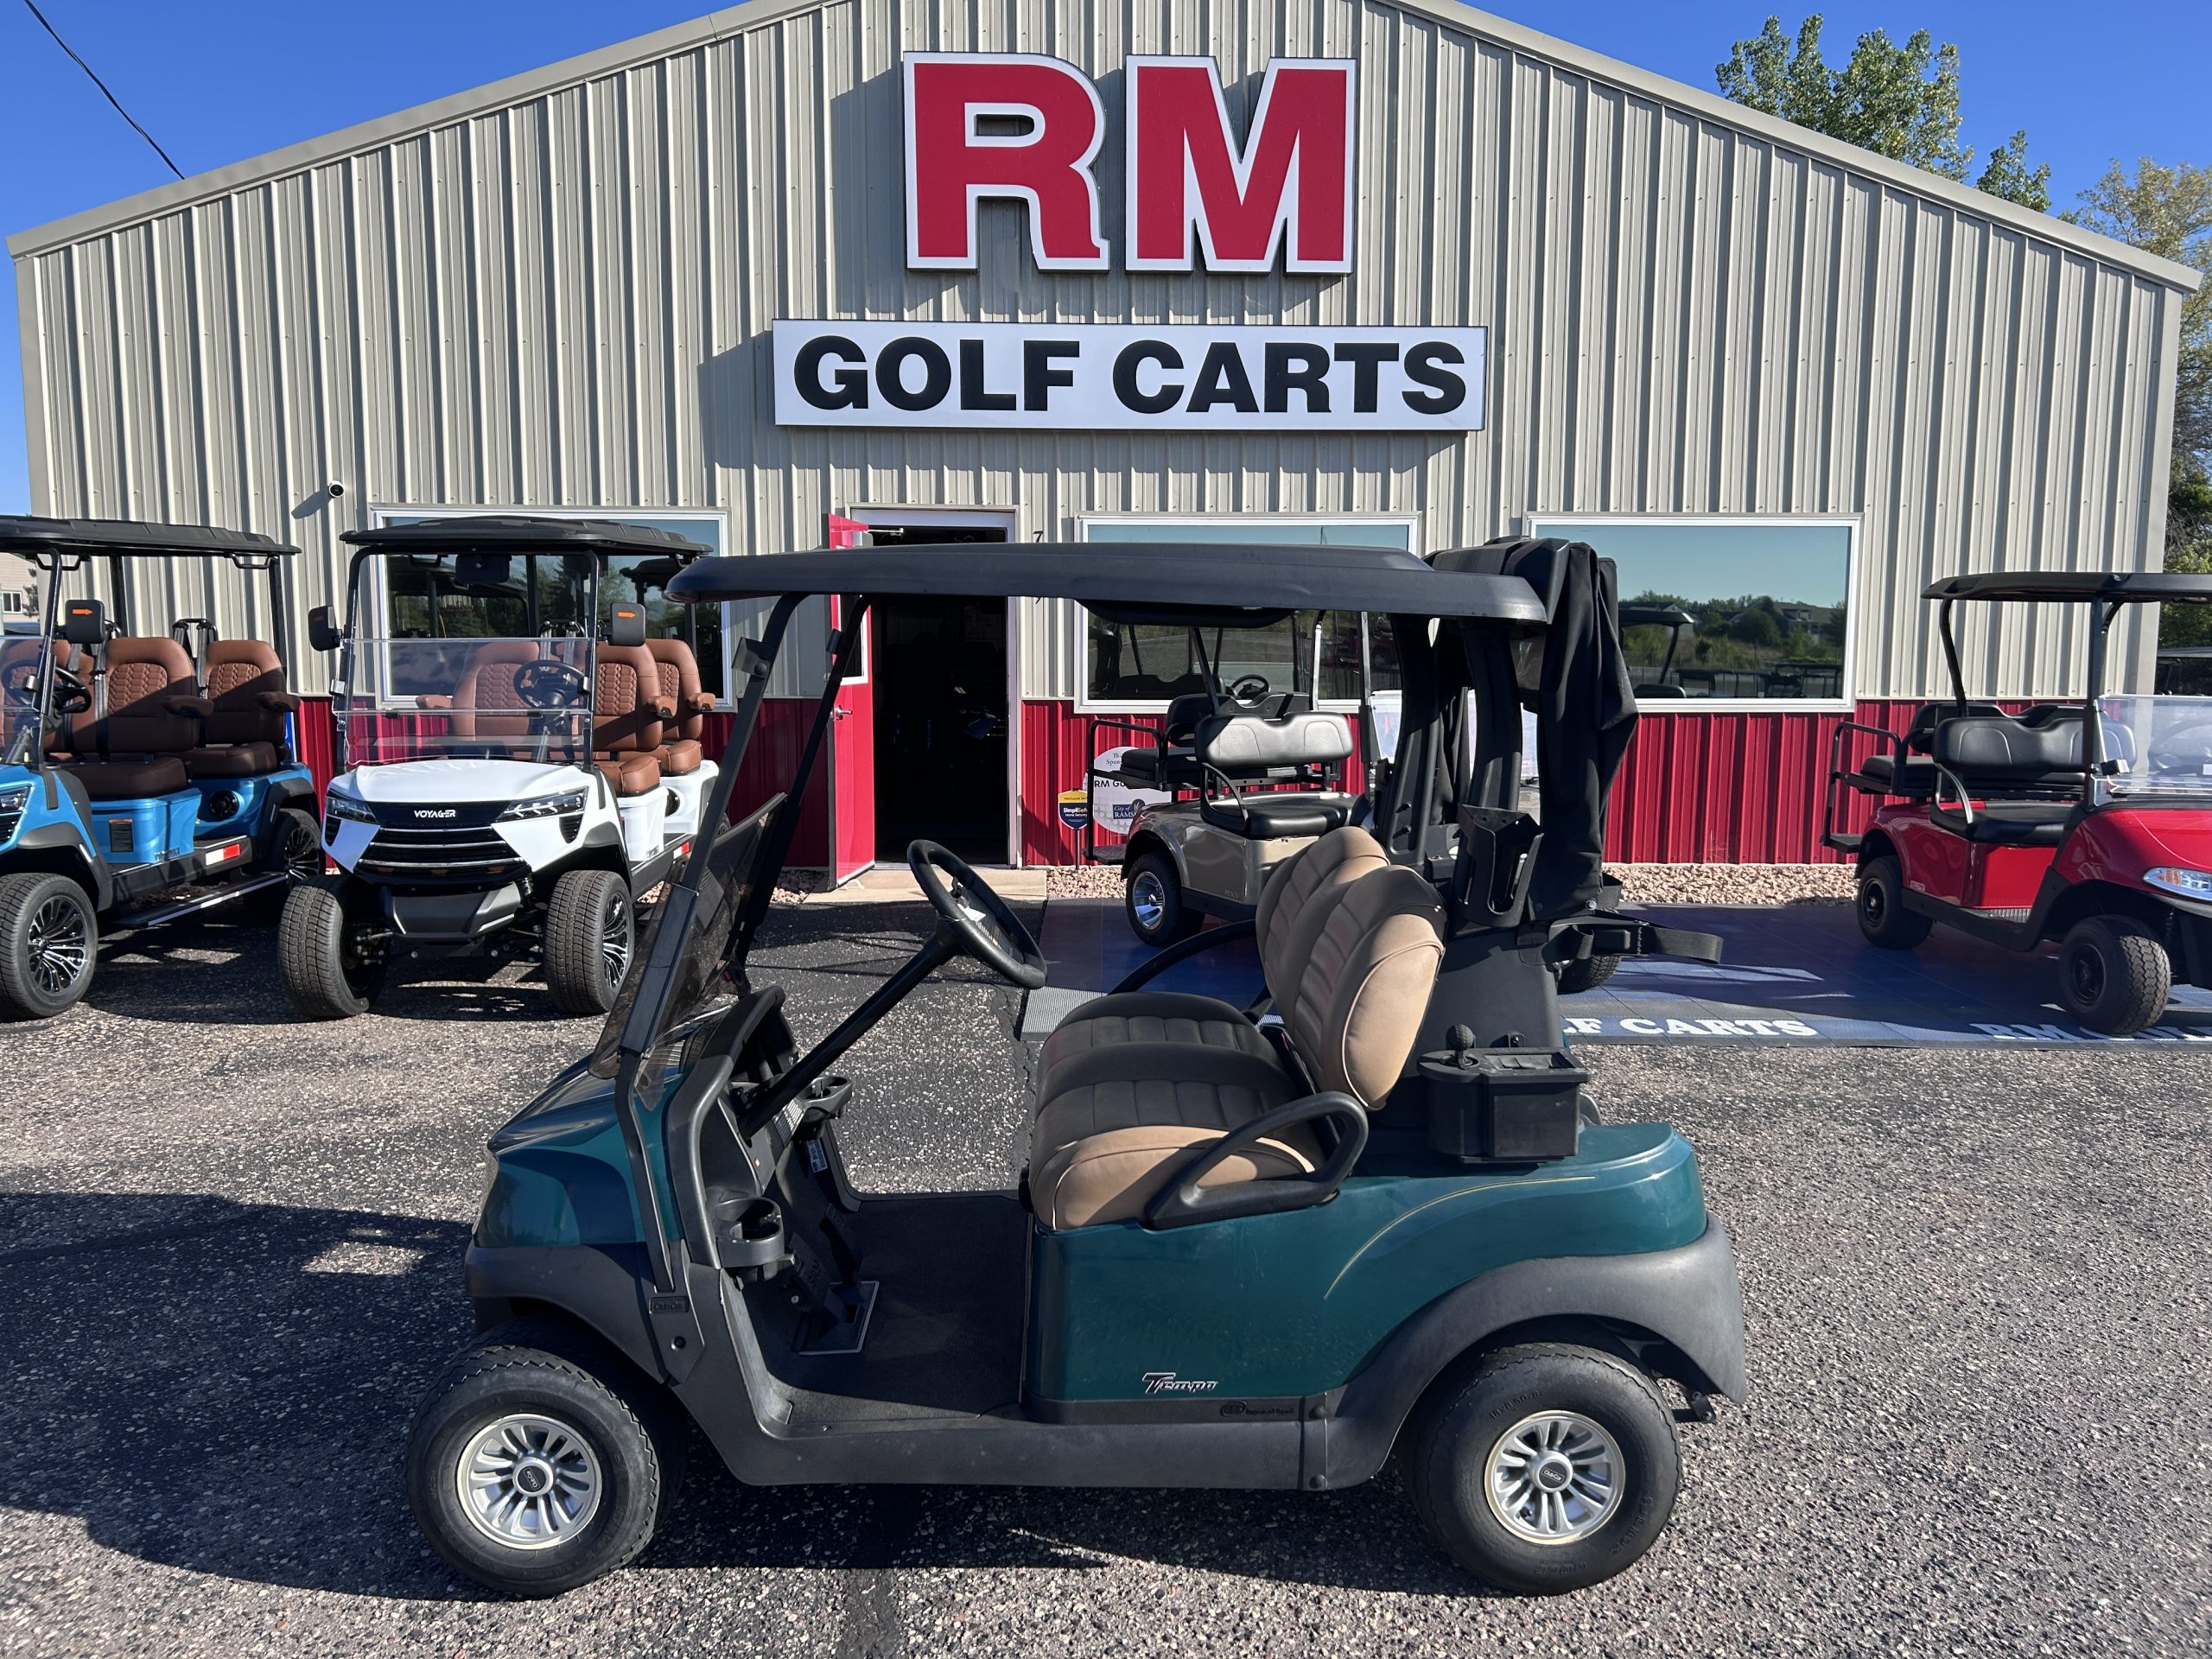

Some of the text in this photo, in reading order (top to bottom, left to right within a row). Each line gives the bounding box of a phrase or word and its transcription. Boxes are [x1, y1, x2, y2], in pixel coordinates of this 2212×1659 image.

[903, 51, 1357, 274] RM
[793, 335, 1467, 415] GOLF CARTS
[414, 809, 456, 818] VOYAGER
[1619, 1018, 1818, 1037] CARTS
[1141, 1371, 1218, 1395] Tempo
